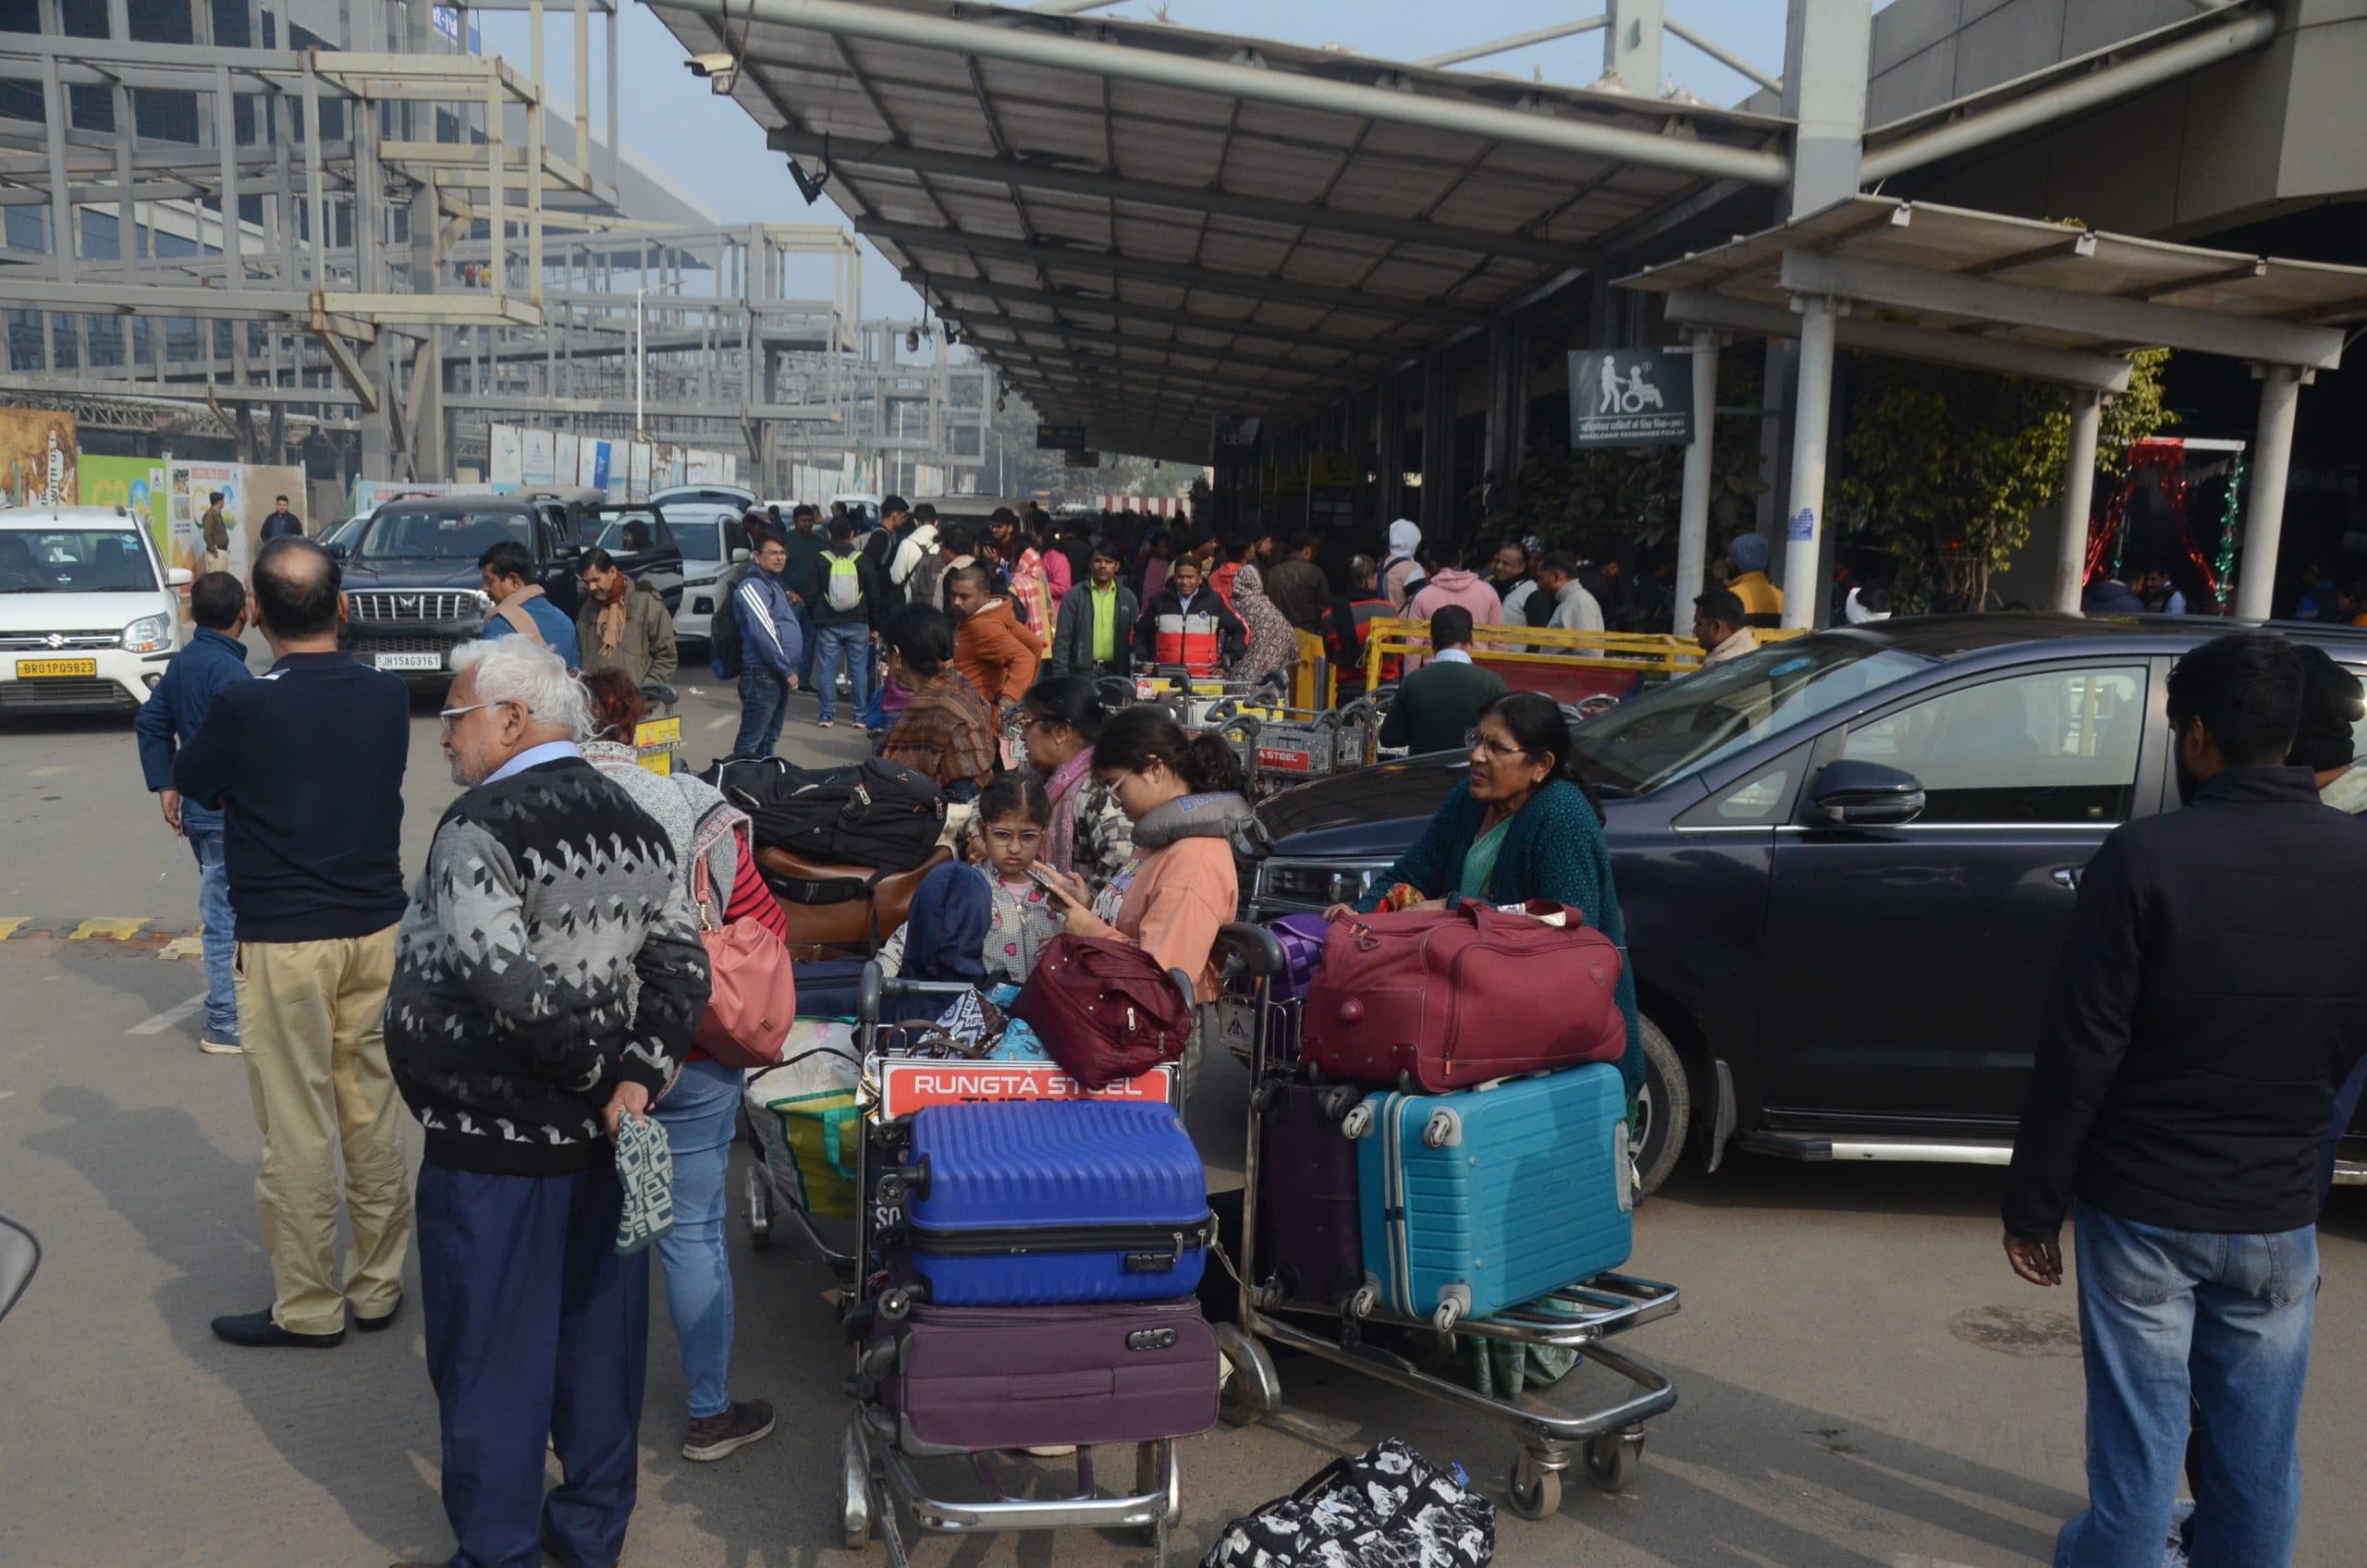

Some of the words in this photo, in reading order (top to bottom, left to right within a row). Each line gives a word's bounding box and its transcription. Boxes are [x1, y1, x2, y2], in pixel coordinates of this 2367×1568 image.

[49, 468, 58, 502] WITH
[383, 656, 439, 667] JH15AG3161
[1267, 751, 1298, 762] STEEL
[914, 1075, 1040, 1095] RUNGTA
